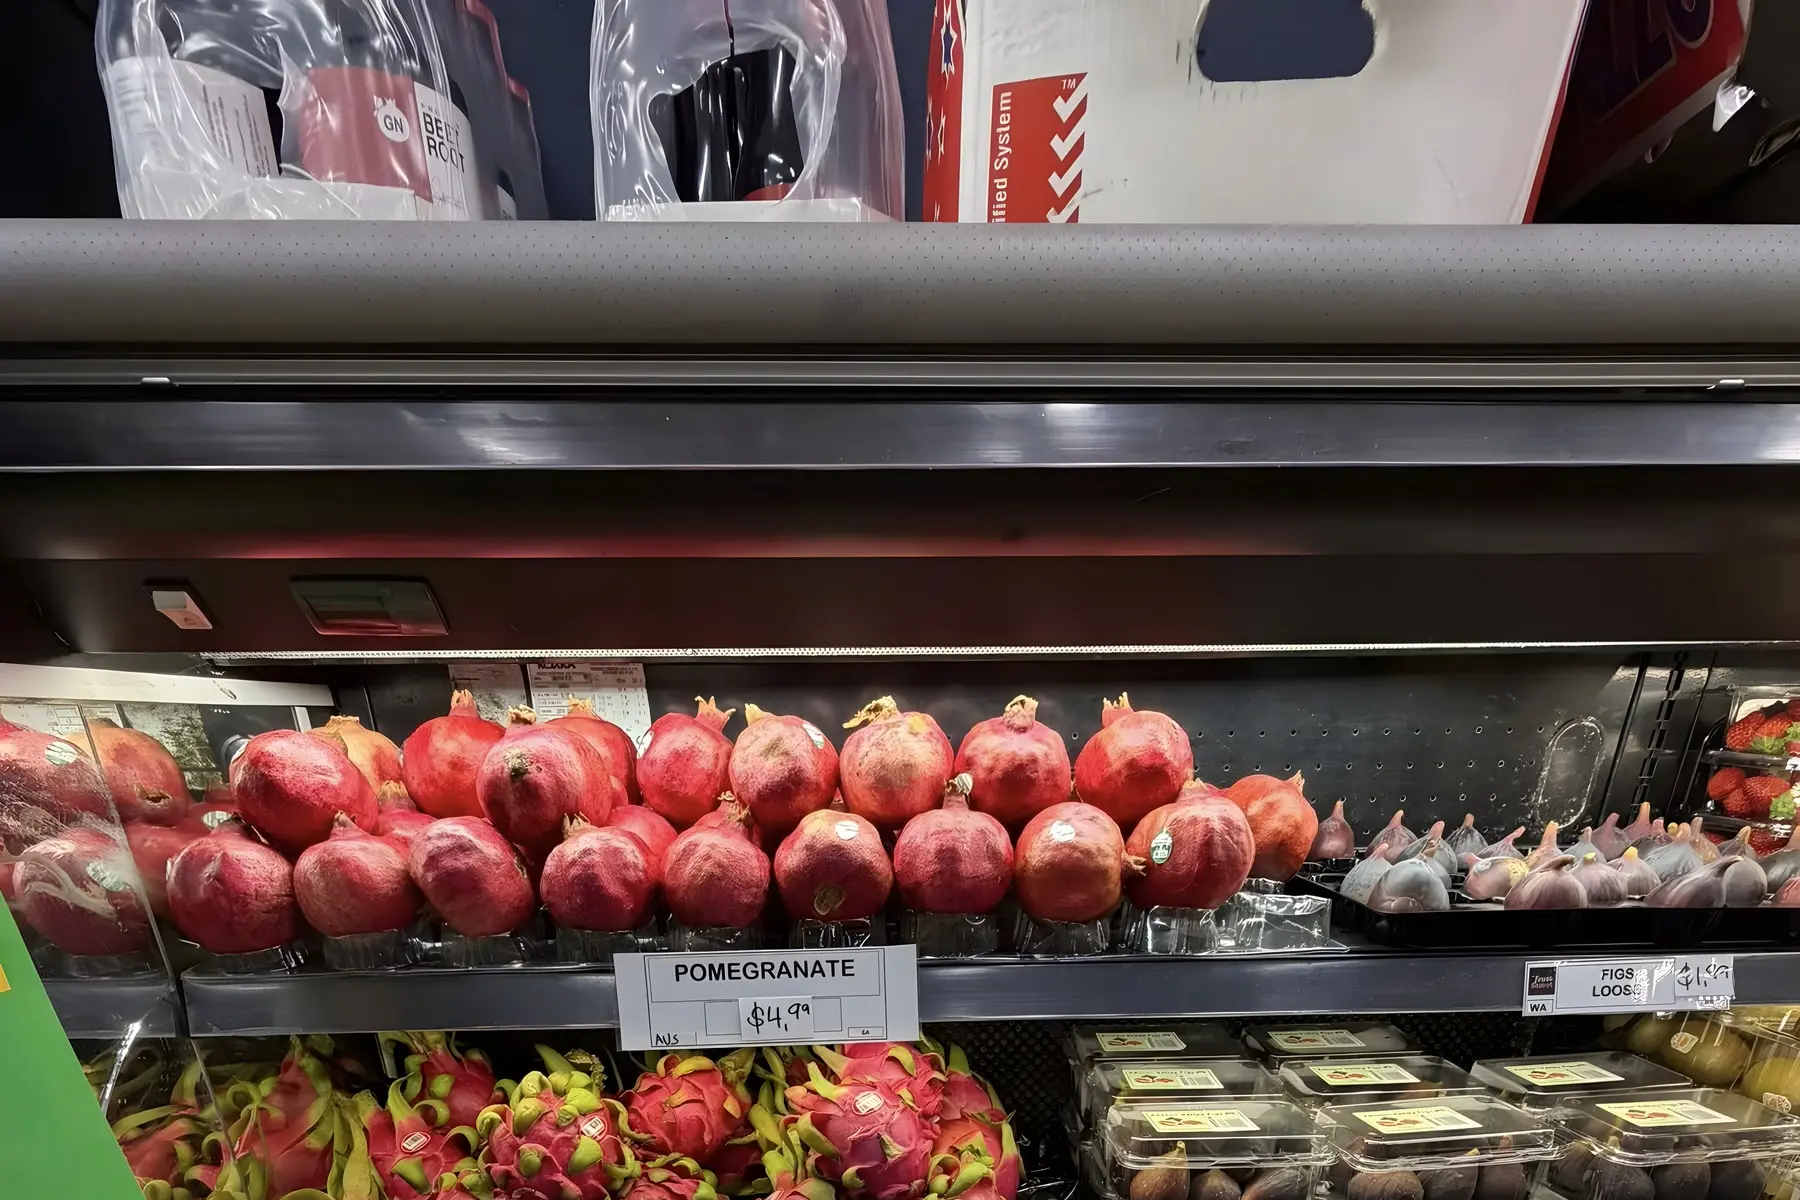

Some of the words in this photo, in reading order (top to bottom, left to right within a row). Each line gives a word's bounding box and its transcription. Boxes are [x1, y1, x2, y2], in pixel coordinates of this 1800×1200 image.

[383, 114, 404, 134] GN
[993, 91, 1013, 172] System
[425, 135, 465, 173] ROOT
[674, 958, 856, 983] POMEGRANATE
[1600, 967, 1635, 981] FIGS
[1529, 1003, 1547, 1012] WA
[654, 1031, 680, 1046] AUS
